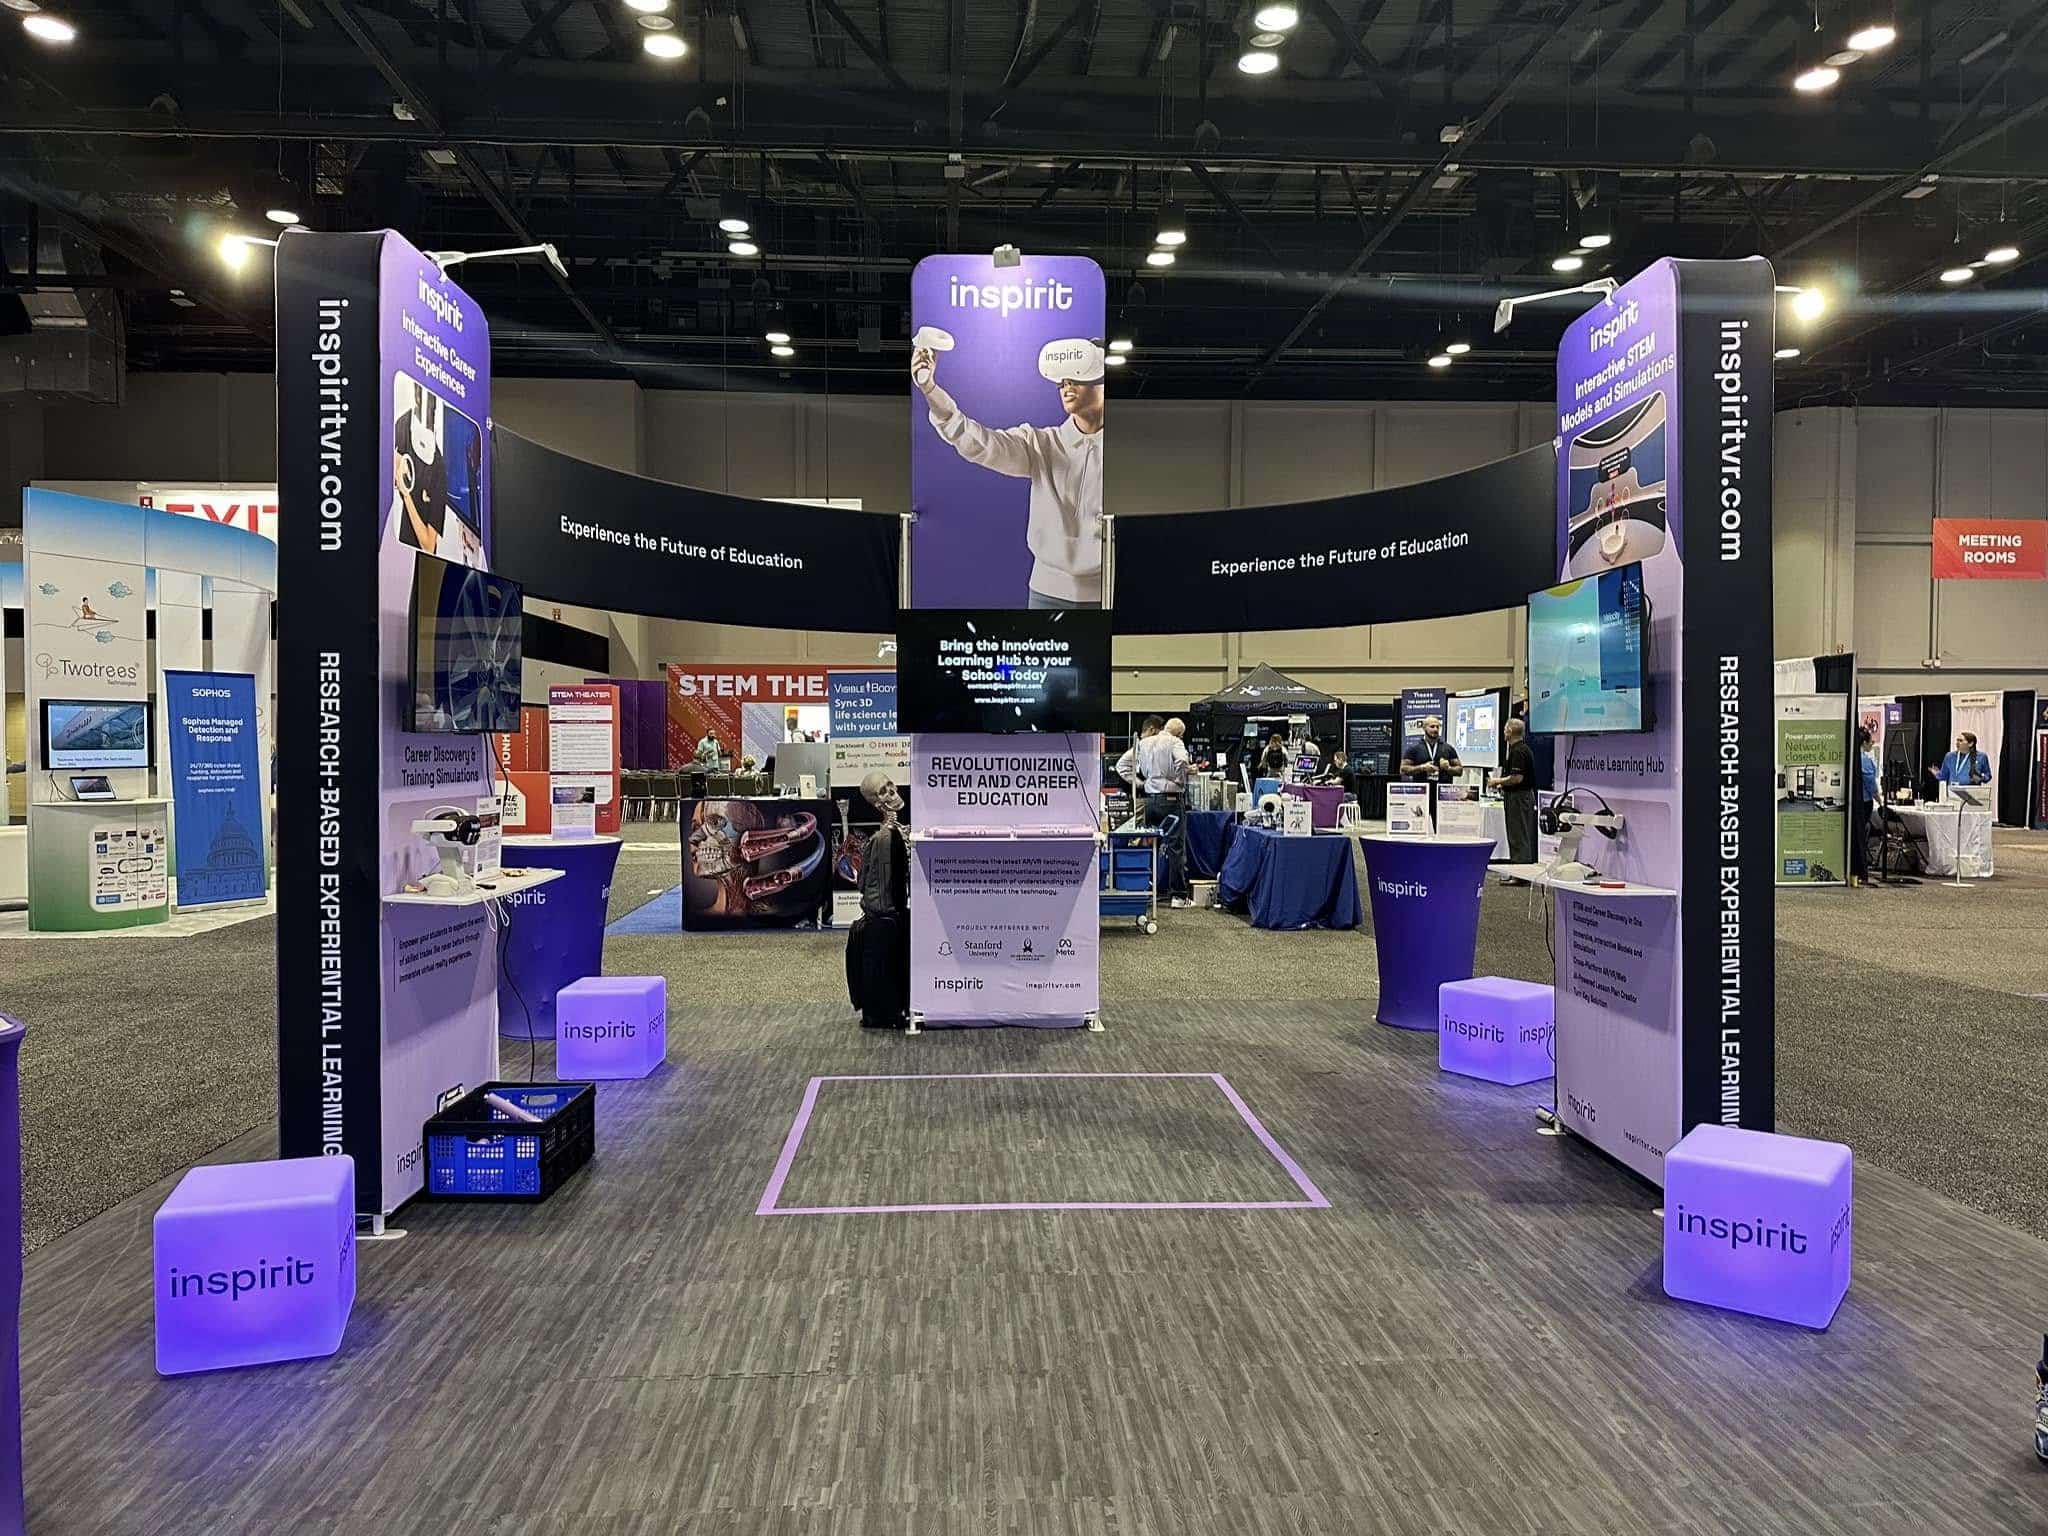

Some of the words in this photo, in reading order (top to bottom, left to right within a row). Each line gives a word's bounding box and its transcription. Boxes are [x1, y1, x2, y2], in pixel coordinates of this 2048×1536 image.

[418, 269, 463, 332] inspirit
[951, 276, 1073, 317] inspirit
[1590, 299, 1639, 352] inspirit
[402, 308, 448, 361] Interactive
[449, 347, 476, 381] Career
[1045, 349, 1084, 362] inspirit
[1575, 355, 1625, 400] Interactive
[1627, 332, 1656, 366] STEM
[415, 346, 466, 398] Experiences
[1561, 402, 1593, 432] Models
[1594, 396, 1612, 413] and
[1614, 353, 1675, 401] Simulations
[312, 299, 349, 551] inspiritvr.com
[1714, 320, 1748, 561] inspiritvr.com
[561, 515, 630, 546] Experience
[634, 533, 657, 550] the
[660, 537, 707, 559] Future
[710, 545, 726, 560] of
[729, 548, 803, 569] Education
[1959, 535, 2022, 547] MEETING
[1211, 556, 1295, 577] Experience
[1299, 552, 1325, 568] the
[1329, 548, 1377, 565] Future
[1380, 542, 1397, 559] of
[1399, 531, 1469, 557] Education
[1963, 551, 2017, 564] ROOMS
[940, 638, 973, 654] Bring
[976, 639, 999, 651] the
[1002, 638, 1069, 652] Innovative
[59, 659, 137, 679] Twotrees
[938, 653, 993, 669] Learning
[996, 654, 1021, 666] Hub
[1024, 655, 1039, 666] to
[1043, 657, 1072, 669] your
[679, 674, 757, 696] STEM
[766, 675, 828, 696] THE
[962, 669, 1005, 681] School
[1009, 669, 1047, 683] Today
[192, 688, 231, 698] SOPHOS
[835, 699, 858, 709] Sync
[859, 698, 873, 707] 3D
[182, 717, 210, 727] Sophos
[211, 718, 243, 727] Managed
[835, 710, 851, 719] life
[852, 710, 887, 719] science
[188, 726, 224, 734] Detection
[225, 726, 238, 734] and
[835, 722, 857, 731] with
[858, 723, 880, 733] your
[196, 735, 232, 743] Response
[1785, 741, 1827, 751] Network
[319, 652, 340, 867] RESEARCH-BASED
[405, 746, 431, 764] Career
[433, 745, 469, 766] Discovery
[931, 756, 1075, 772] REVOLUTIONIZING
[1606, 756, 1644, 775] Learning
[1646, 757, 1664, 773] Hub
[1720, 655, 1739, 860] RESEARCH-BASED
[1785, 752, 1817, 761] closets
[401, 768, 435, 788] Training
[436, 767, 479, 784] Simulations
[928, 774, 972, 788] STEM
[977, 775, 1010, 788] AND
[1016, 775, 1078, 789] CAREER
[957, 792, 1048, 806] EDUCATION
[1377, 877, 1428, 898] inspirit
[964, 939, 1002, 950] Stanford
[968, 950, 998, 958] University
[1720, 867, 1740, 1024] EXPERIENTIAL
[320, 874, 342, 1038] EXPERIENTIAL
[935, 977, 983, 992] inspirit
[1026, 982, 1081, 990] inspiritvr.com
[564, 1022, 636, 1043] inspirit
[1444, 1014, 1505, 1043] inspirit
[1721, 1029, 1740, 1128] LEARNIN
[1567, 1088, 1596, 1122] inspirit
[1678, 1204, 1807, 1254] inspirit
[170, 1256, 314, 1301] inspirit
